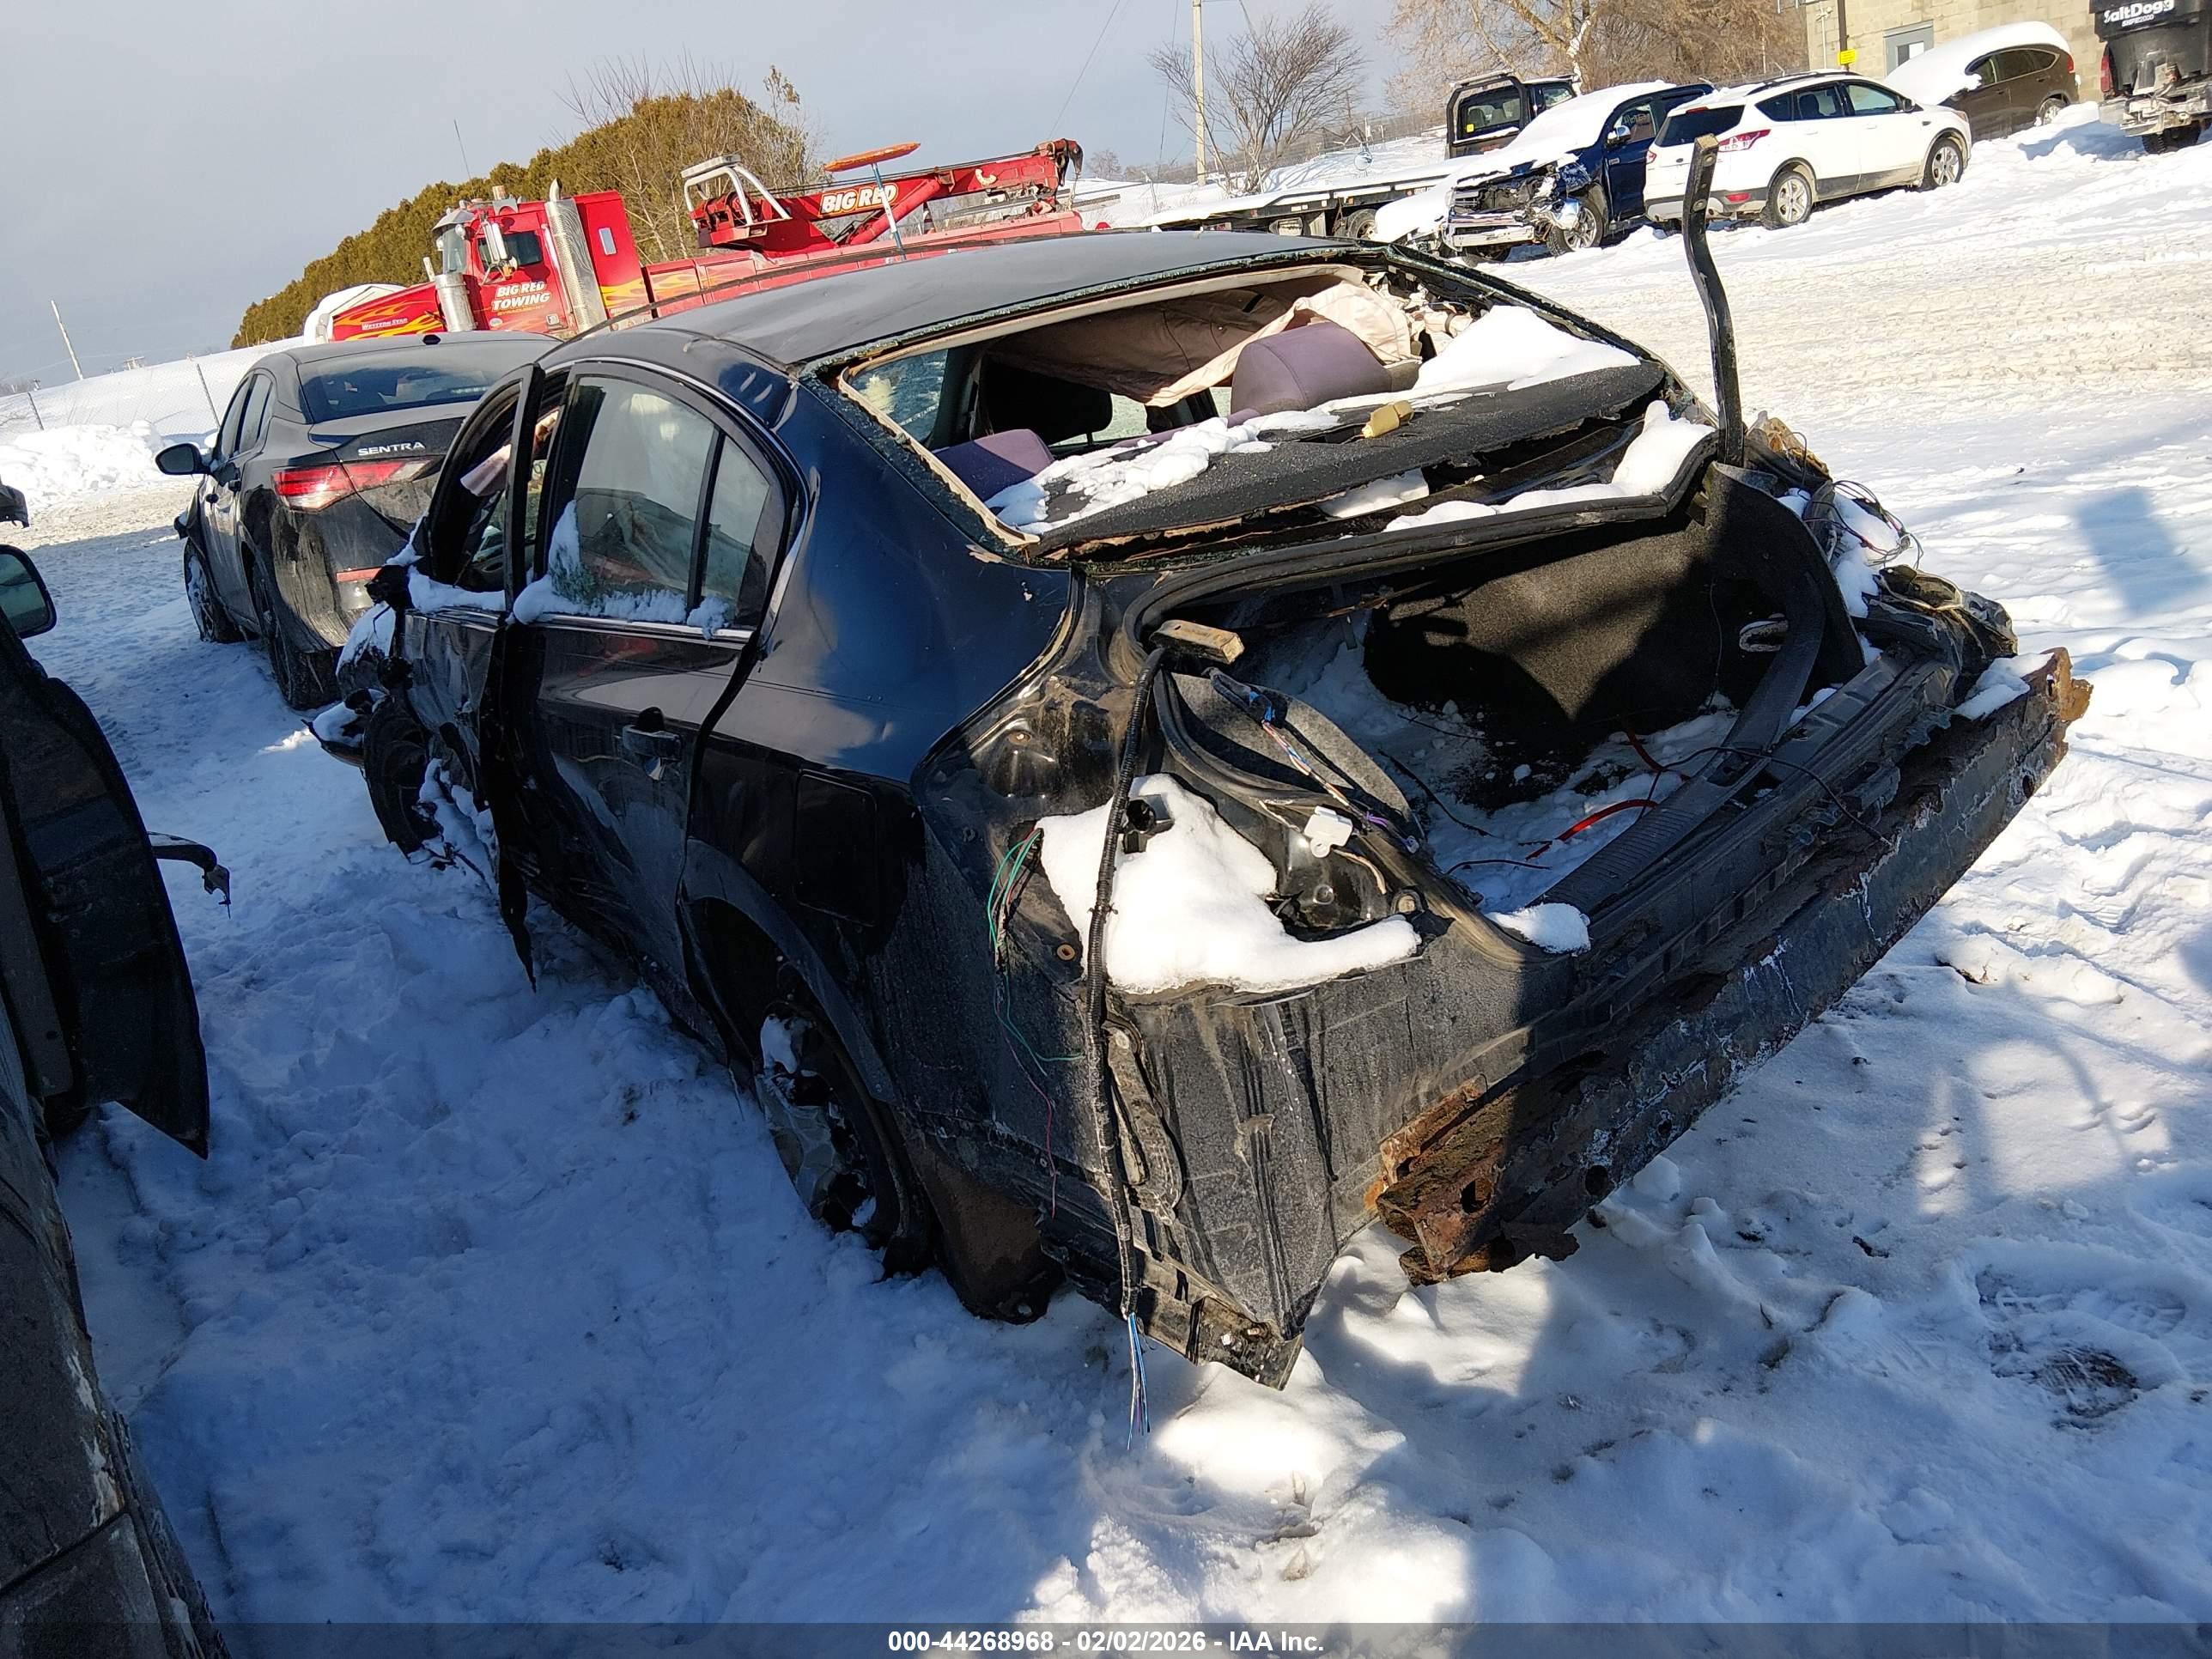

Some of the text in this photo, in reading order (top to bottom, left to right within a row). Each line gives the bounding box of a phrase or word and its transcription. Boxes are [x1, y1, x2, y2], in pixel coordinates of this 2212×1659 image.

[2104, 0, 2175, 23] SaltDogg
[821, 184, 897, 213] BIG RED
[496, 281, 545, 298] BIG RED
[493, 292, 551, 311] TOWING
[357, 441, 426, 456] SENTRA
